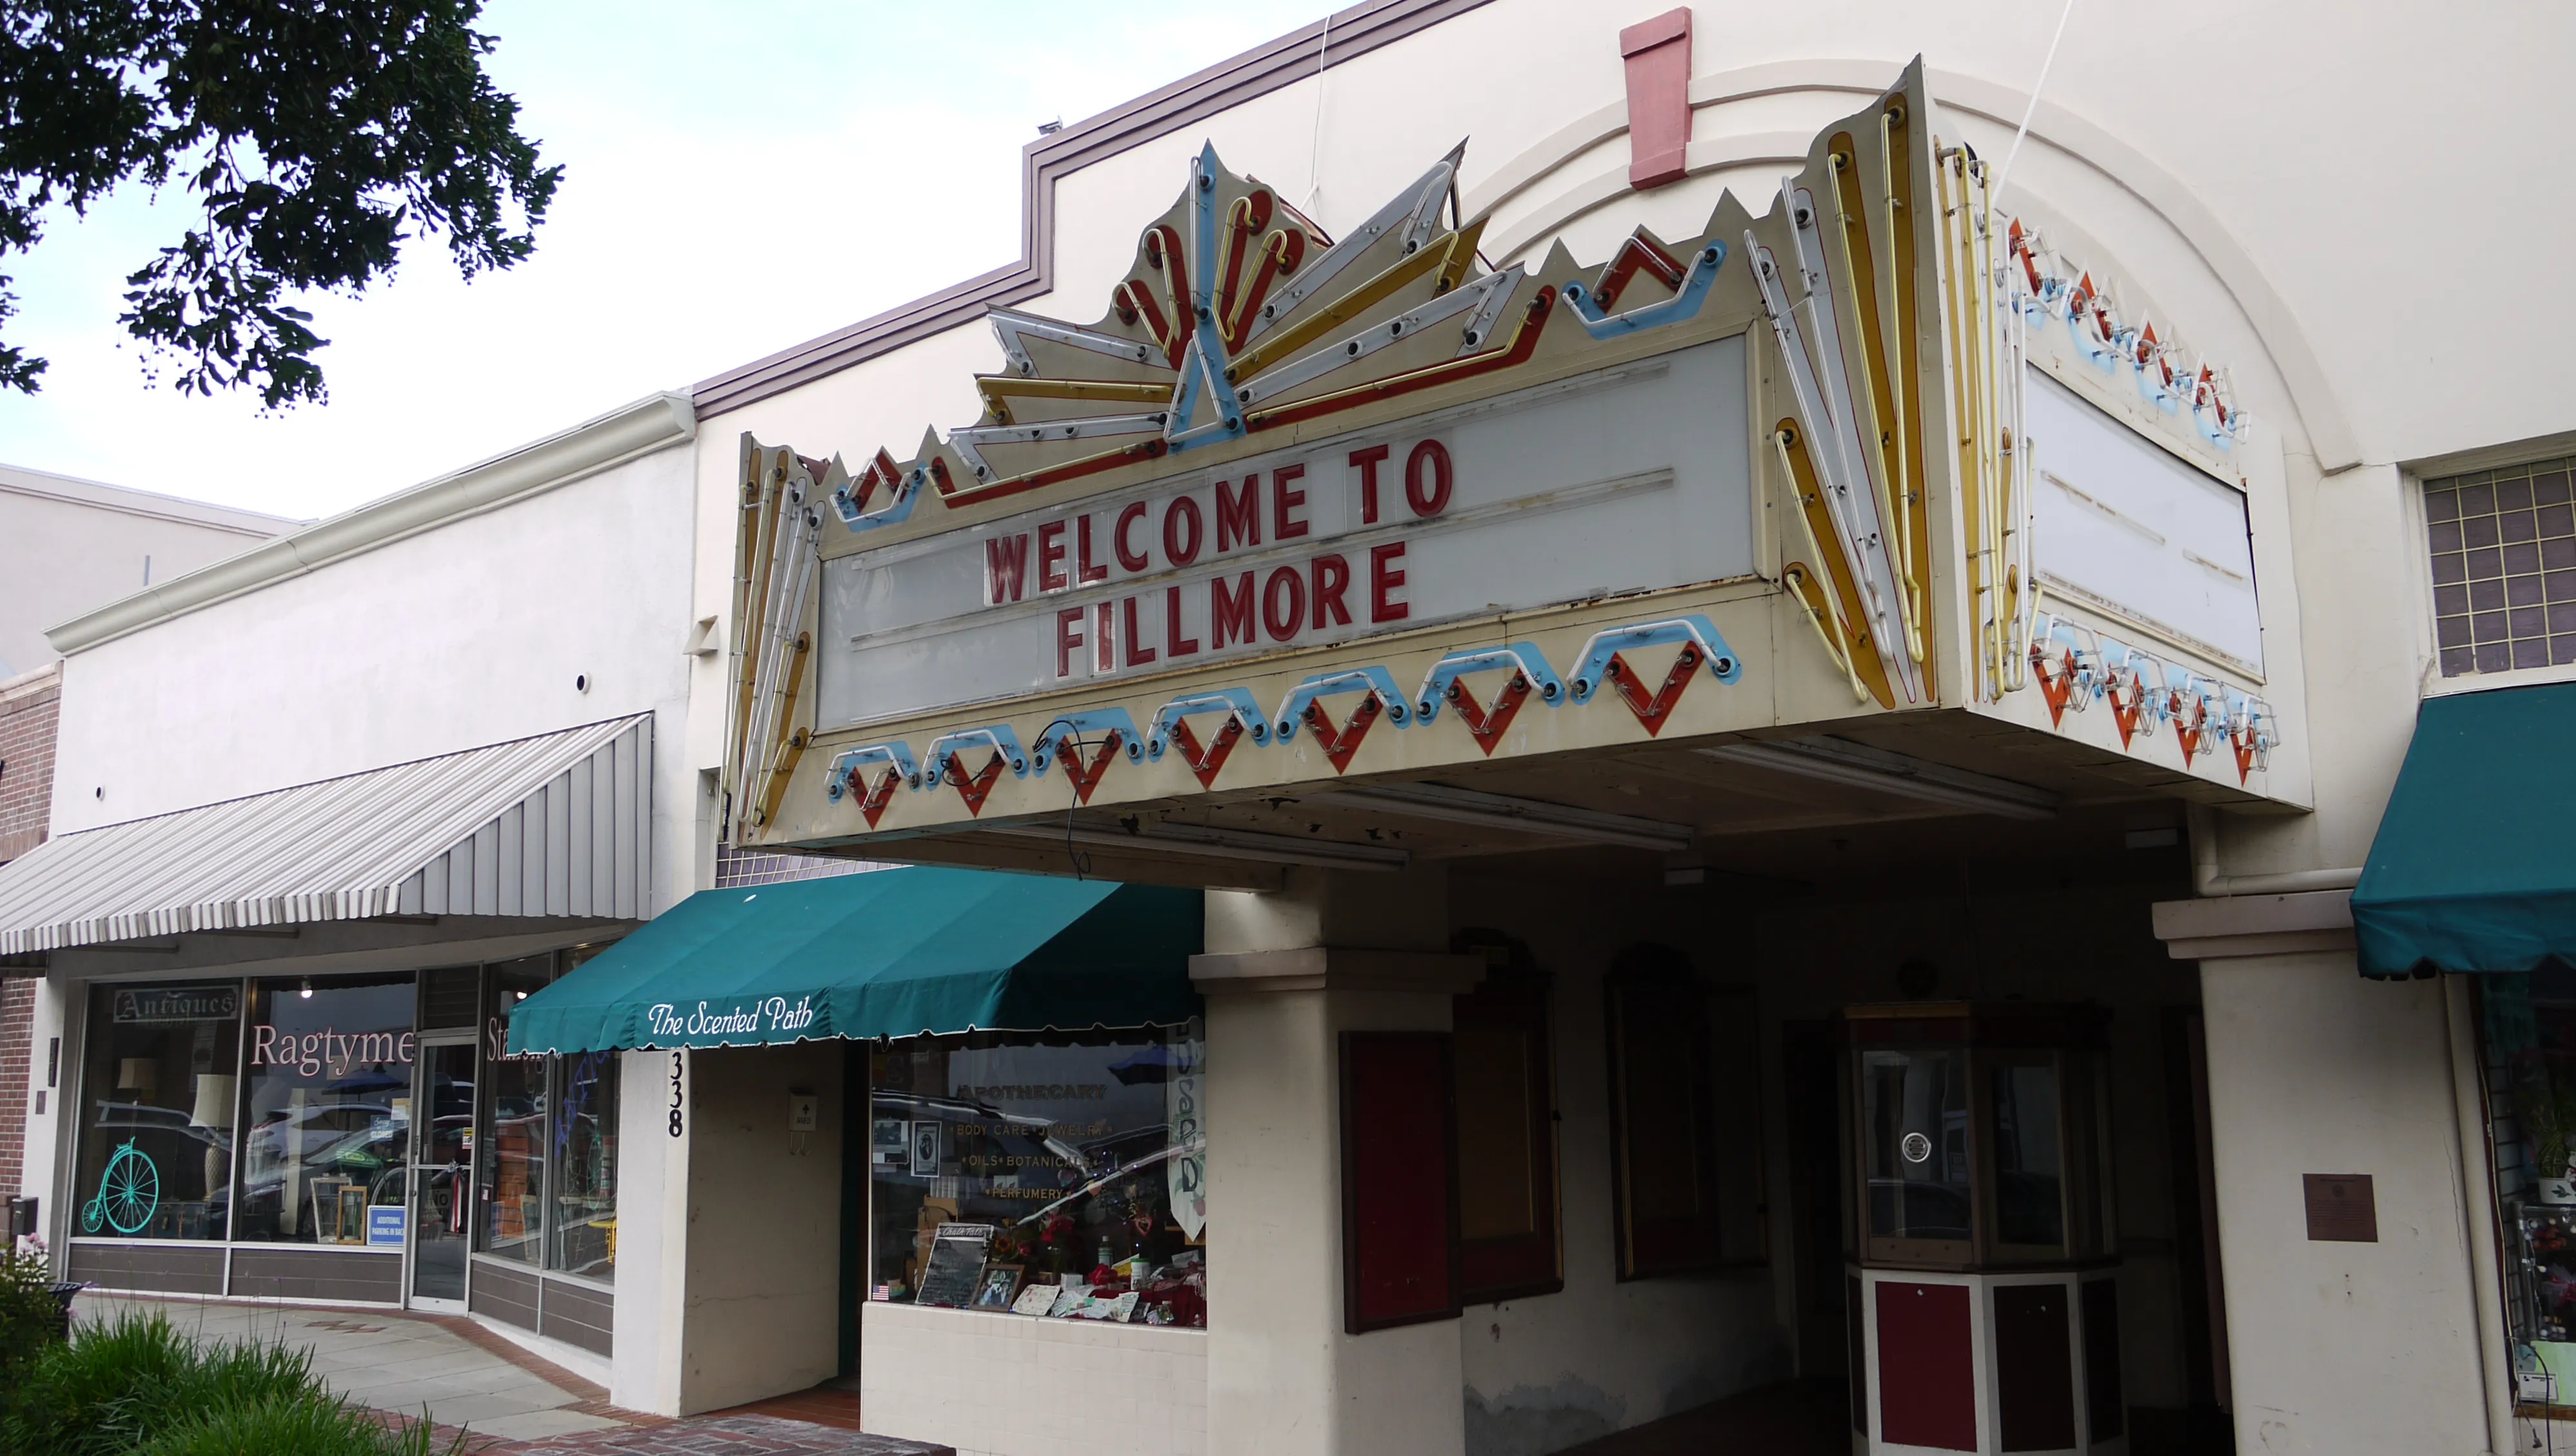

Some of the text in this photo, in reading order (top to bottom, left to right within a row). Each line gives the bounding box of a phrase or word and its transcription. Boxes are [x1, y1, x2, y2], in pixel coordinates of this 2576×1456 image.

[985, 438, 1452, 604] WELCOME TO
[1057, 540, 1410, 678] FILLMORE
[119, 992, 234, 1018] Antiques
[649, 995, 814, 1036] The Scented Path
[251, 1025, 414, 1077] Ragtyme
[668, 1051, 683, 1138] 338
[957, 1083, 1107, 1101] APOTHECARY
[957, 1125, 1104, 1137] BODY CARE JEWELRY
[969, 1155, 1091, 1168] OILS BOTANICALS
[991, 1188, 1063, 1200] PERFUMERY
